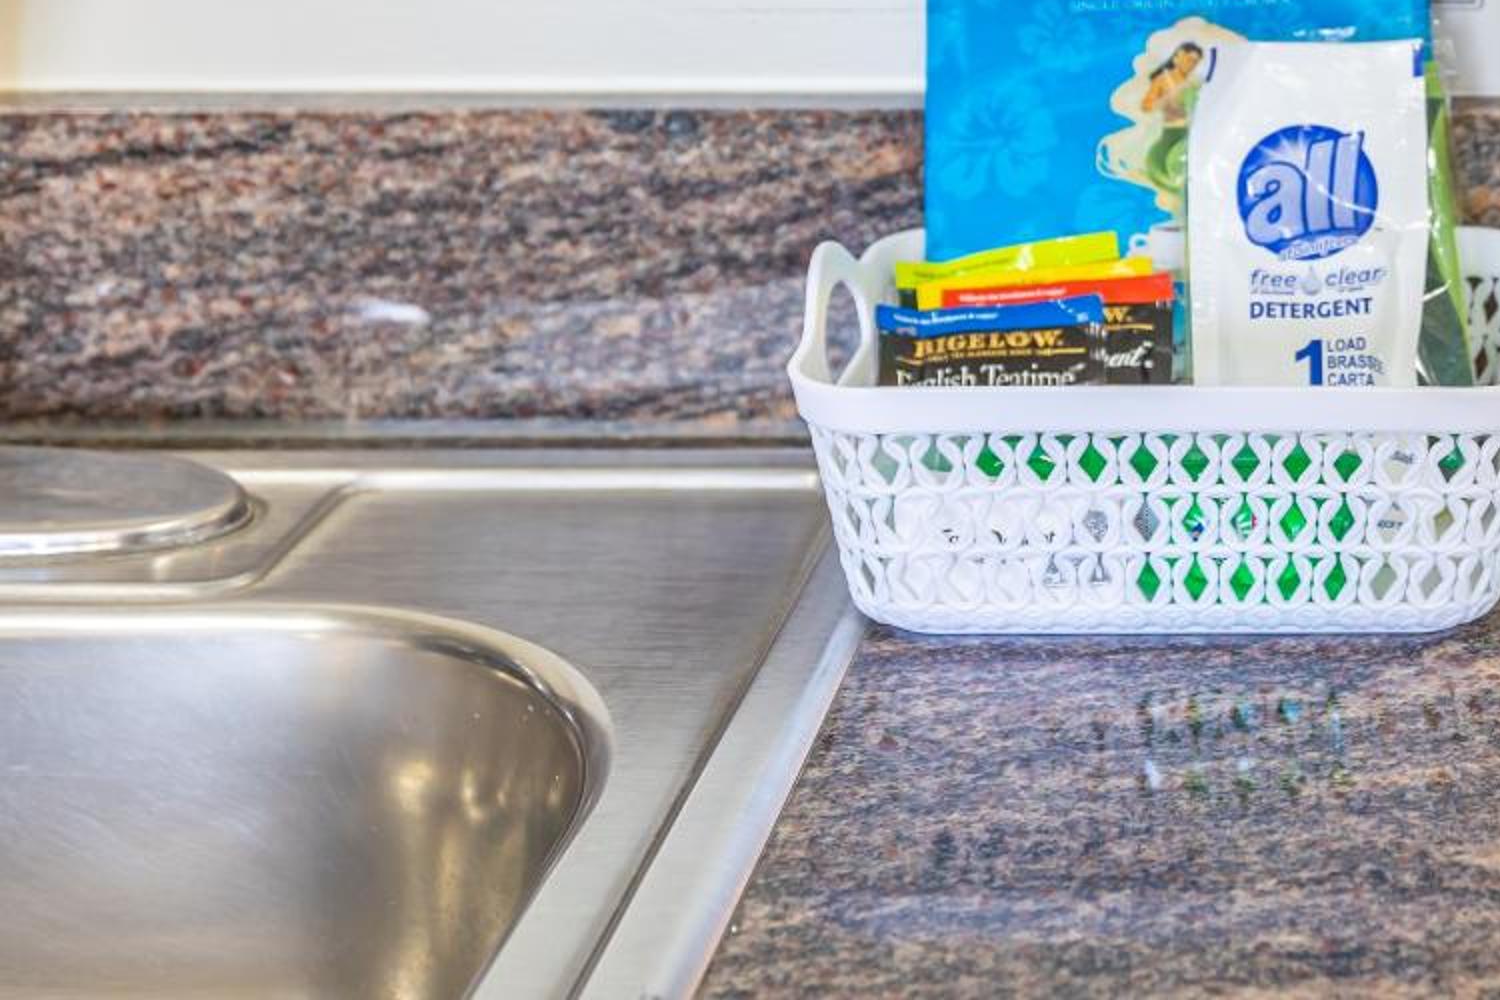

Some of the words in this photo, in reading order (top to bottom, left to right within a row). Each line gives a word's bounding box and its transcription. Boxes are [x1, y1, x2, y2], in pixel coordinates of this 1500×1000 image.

[1244, 130, 1366, 244] all
[1250, 269, 1297, 290] free
[1325, 267, 1381, 288] clear
[1250, 297, 1373, 319] DETERGENT
[1327, 337, 1367, 352] LOAD
[896, 362, 977, 387] Eglish
[980, 364, 1078, 387] Teatime
[1295, 339, 1323, 386] 1
